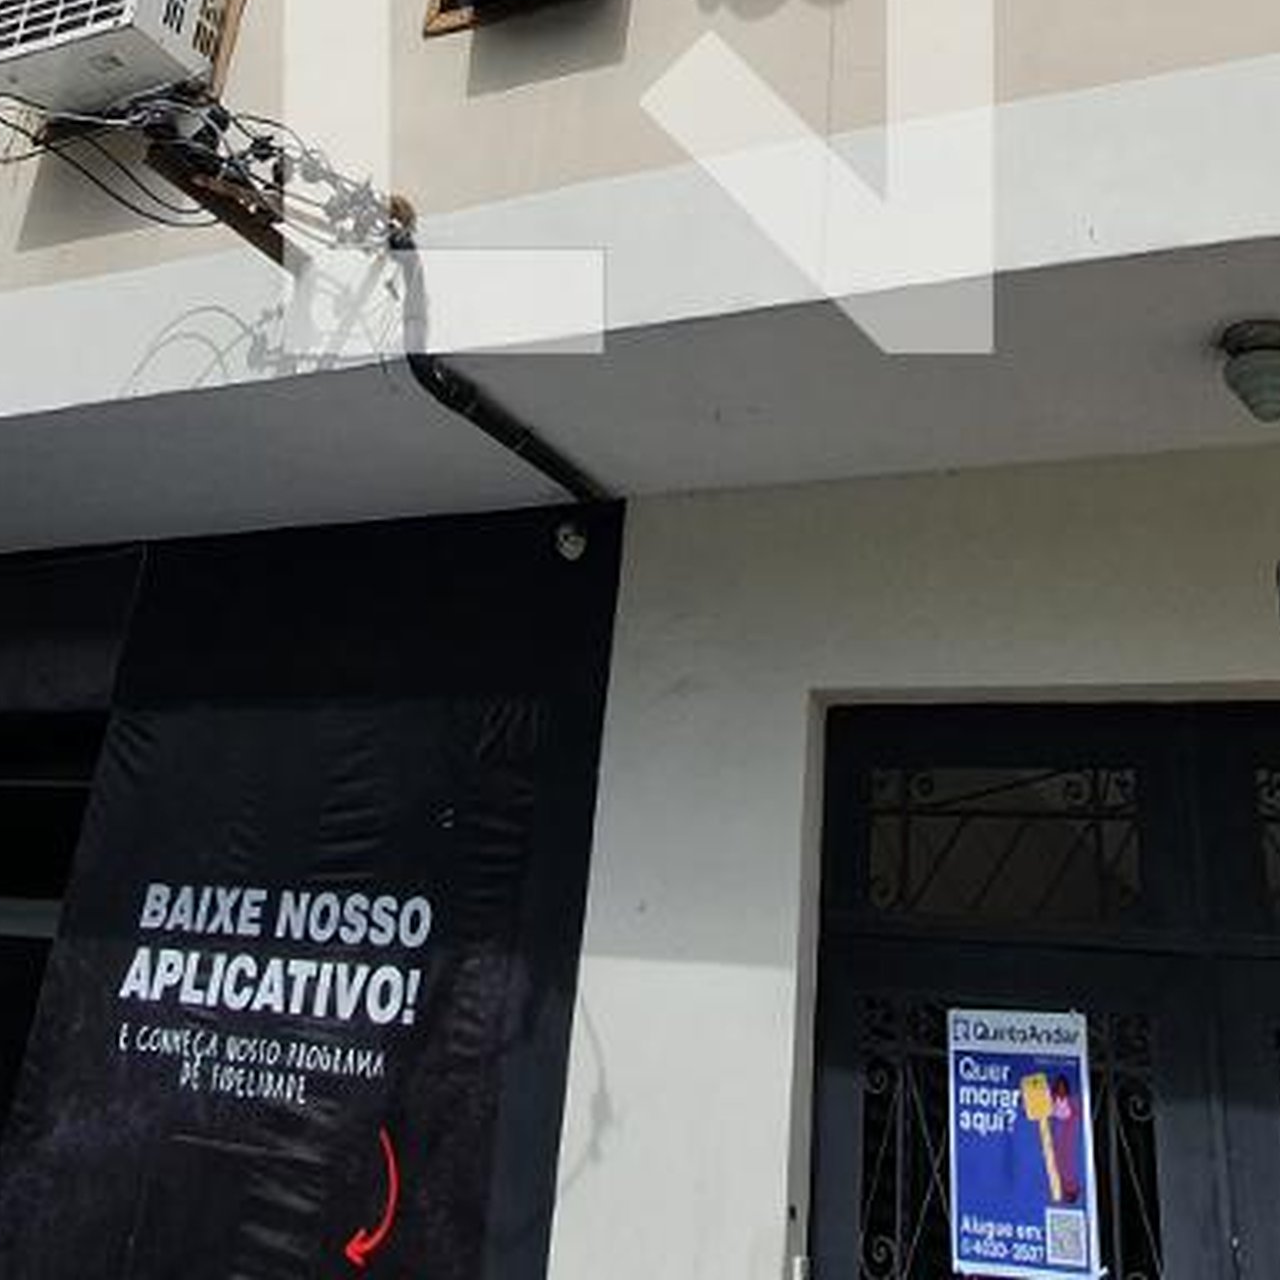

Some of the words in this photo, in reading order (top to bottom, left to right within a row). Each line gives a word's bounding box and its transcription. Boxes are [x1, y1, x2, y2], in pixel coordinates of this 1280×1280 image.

[140, 882, 268, 937] BAIXE
[274, 889, 433, 949] NOSSO
[118, 945, 422, 1025] APLICATIVO!
[225, 1034, 282, 1066] NOSSO
[285, 1041, 386, 1079] PROGRAMA
[959, 1056, 1010, 1082] Quer
[178, 1060, 201, 1091] DE
[210, 1063, 307, 1104] FIDELIDADE
[959, 1086, 1020, 1109] morar
[959, 1109, 1017, 1135] aqui?
